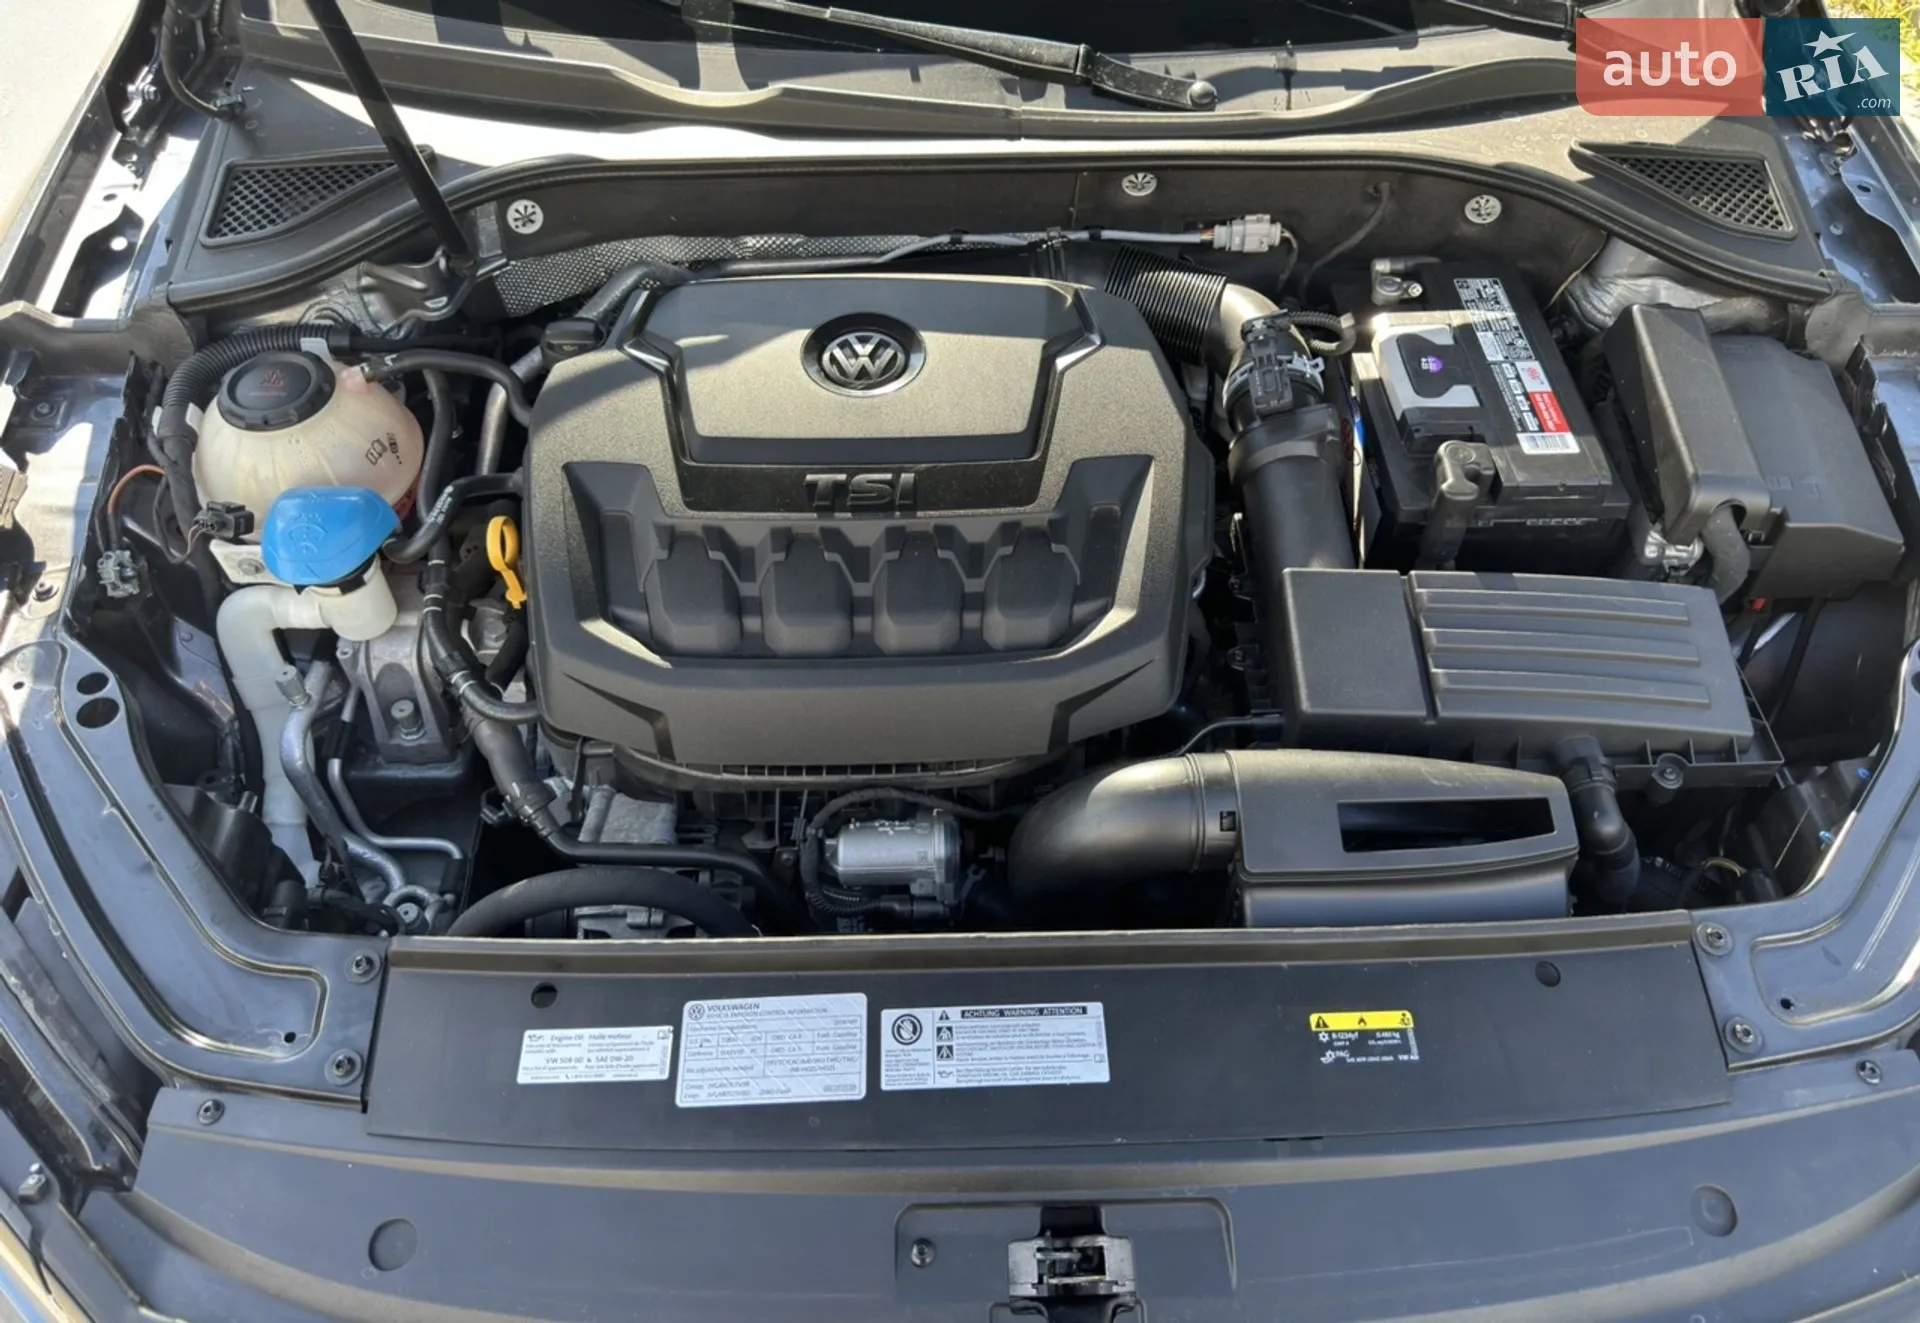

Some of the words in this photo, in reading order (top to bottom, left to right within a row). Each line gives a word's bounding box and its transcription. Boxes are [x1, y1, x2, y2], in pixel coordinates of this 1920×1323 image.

[805, 472, 916, 507] TSI
[706, 1002, 760, 1013] VOLKSWAGEN
[760, 1009, 786, 1017] CONTROL
[787, 1007, 828, 1016] INFORMATION
[963, 1009, 1000, 1018] ACHTUNG
[1004, 1007, 1039, 1017] WARNING
[1043, 1006, 1083, 1016] ATTENTION
[551, 1034, 573, 1043] Engine
[588, 1033, 606, 1041] Huile
[607, 1033, 632, 1041] moteur
[545, 1057, 559, 1065] VW
[573, 1056, 584, 1064] 00
[595, 1056, 608, 1064] SAE
[609, 1055, 634, 1063] 0W-20
